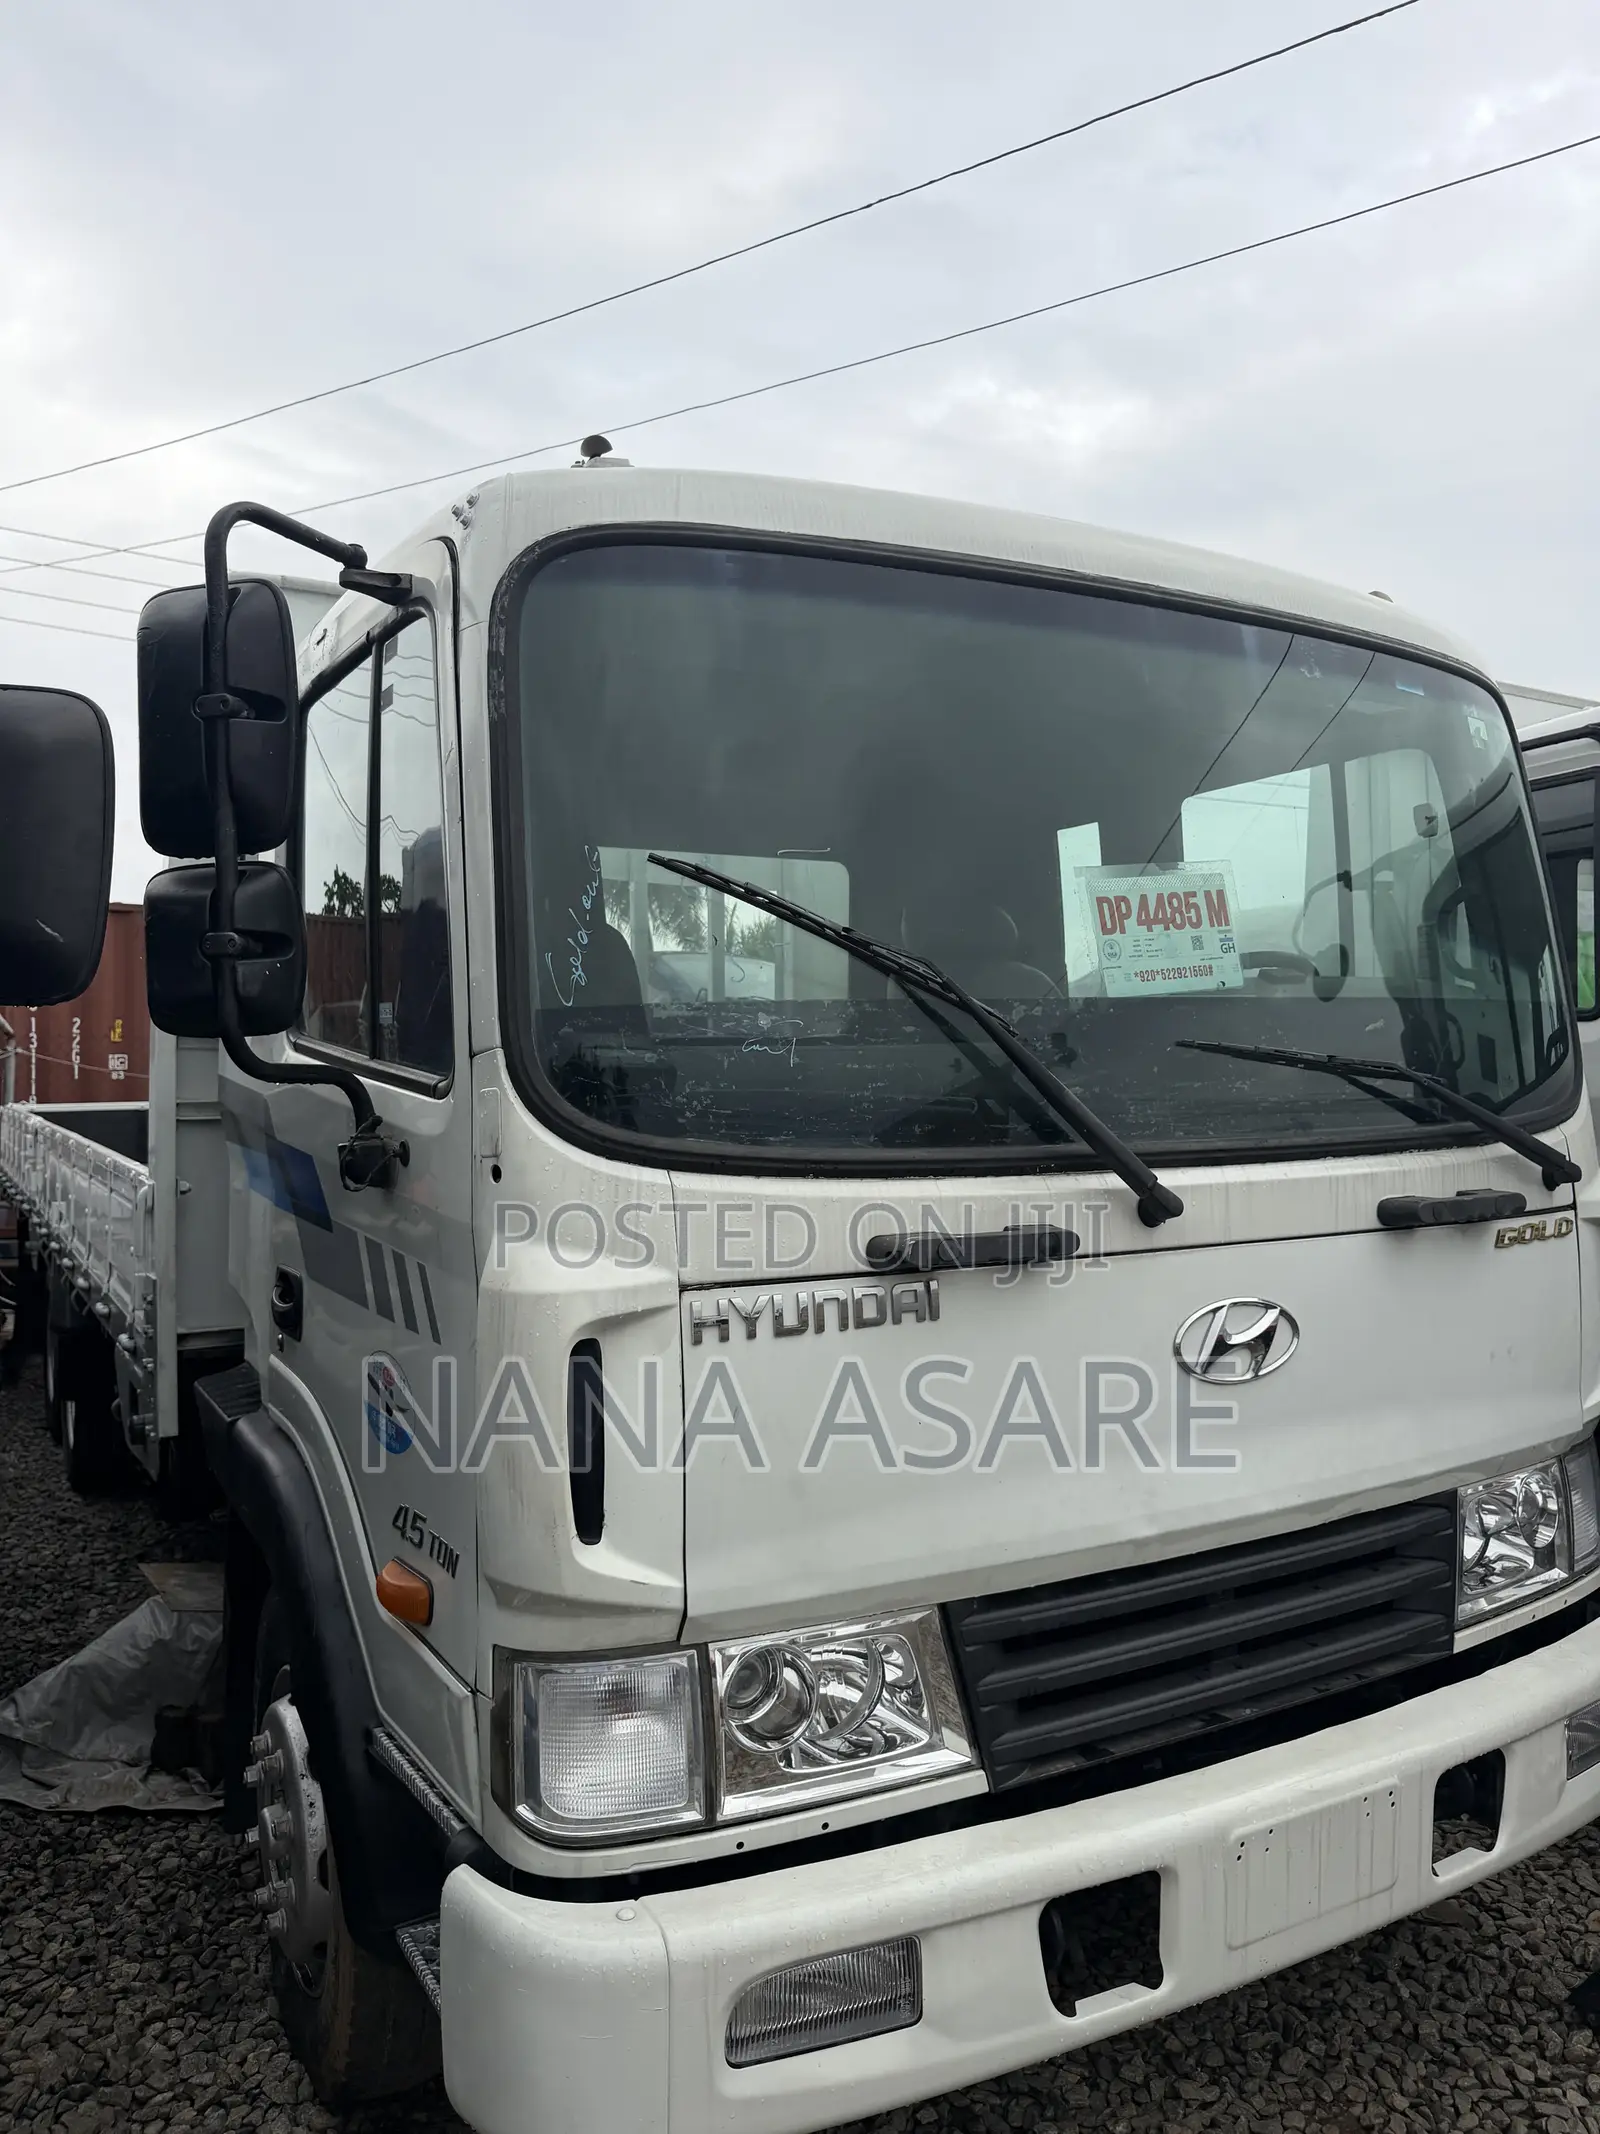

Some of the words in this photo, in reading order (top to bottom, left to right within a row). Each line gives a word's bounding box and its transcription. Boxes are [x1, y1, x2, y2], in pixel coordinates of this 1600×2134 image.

[1096, 895, 1132, 936] DP
[1137, 891, 1203, 932] 4485
[1220, 943, 1236, 954] GH
[72, 1017, 81, 1079] 22G1
[1494, 1216, 1573, 1248] GOLD
[690, 1279, 940, 1346] HYUNDAI
[428, 1528, 460, 1579] TON
